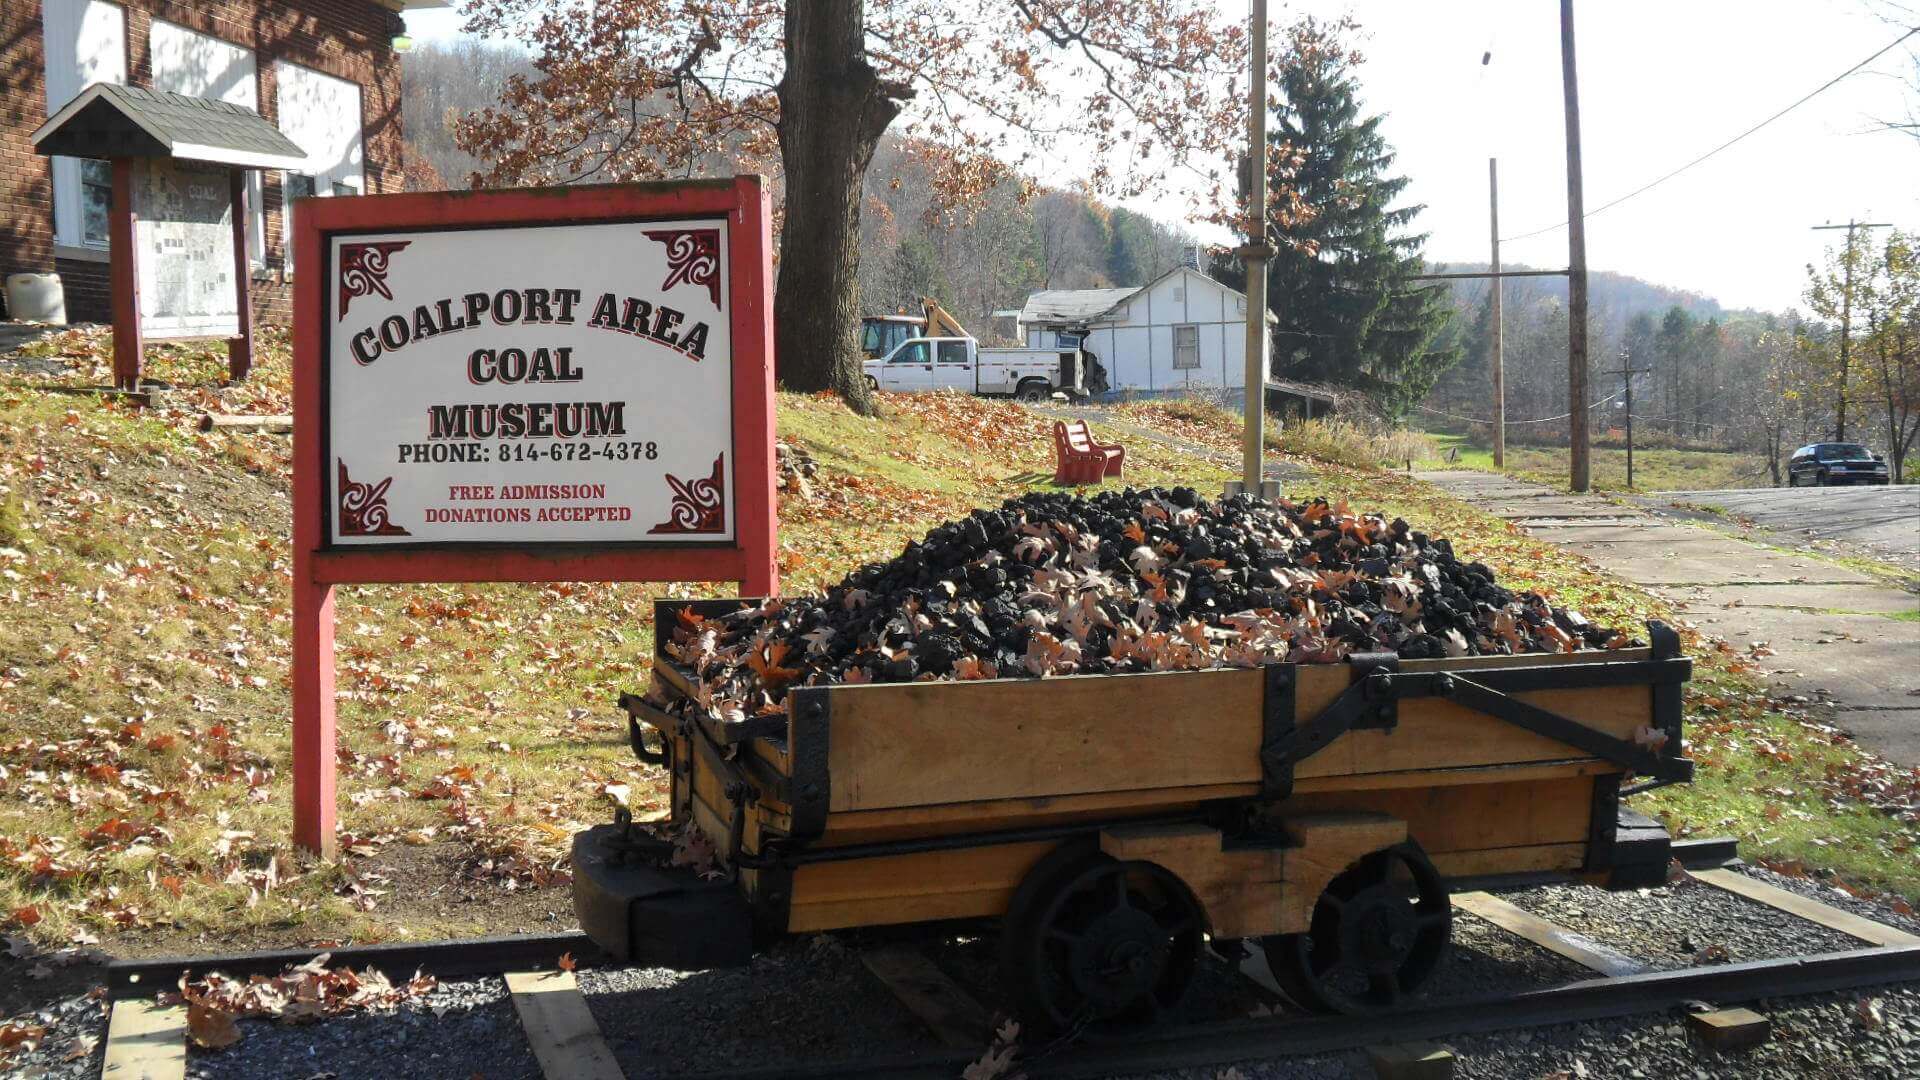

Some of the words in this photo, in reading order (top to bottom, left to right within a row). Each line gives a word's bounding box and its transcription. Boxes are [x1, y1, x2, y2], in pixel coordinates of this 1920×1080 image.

[350, 288, 581, 366] COALPORT
[587, 292, 711, 363] AREA
[467, 347, 583, 385] COAL
[427, 401, 627, 441] MUSEUM
[398, 443, 491, 463] PHONE:
[498, 441, 659, 462] 814-672-4378
[449, 485, 495, 501] FREE
[499, 484, 606, 500] ADMISSION
[425, 507, 532, 523] DONATIONS
[537, 506, 632, 522] ACCEPTED
